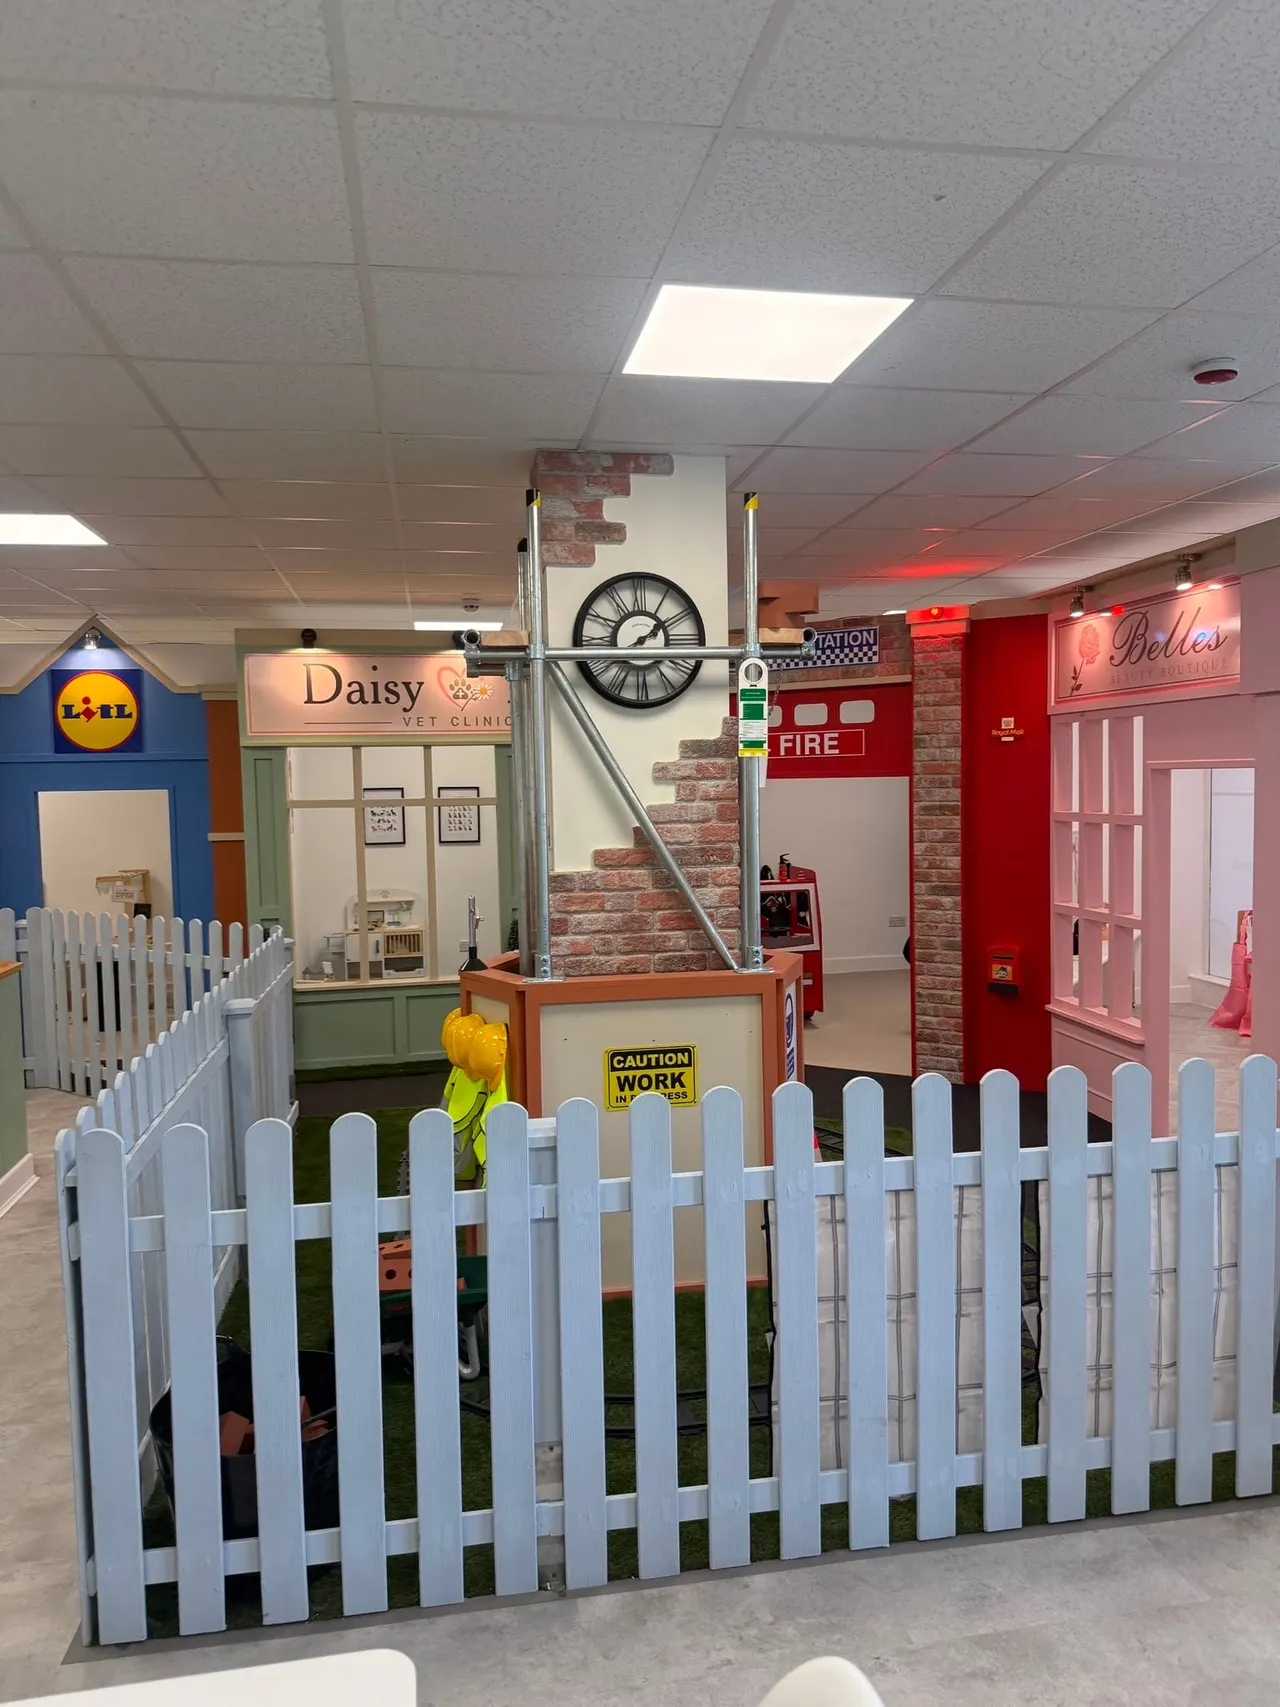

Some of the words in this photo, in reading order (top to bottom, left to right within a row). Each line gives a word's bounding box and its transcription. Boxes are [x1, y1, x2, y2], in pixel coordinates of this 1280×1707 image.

[816, 630, 874, 649] TATION
[1109, 607, 1228, 667] Belles
[1110, 668, 1154, 685] BEAUTY
[1160, 657, 1229, 678] BOUTIQUE
[302, 663, 425, 713] Daisy
[402, 716, 437, 727] VET
[451, 716, 512, 727] CLINIC
[991, 729, 1010, 737] Royal
[780, 732, 840, 756] FIRE
[613, 1053, 688, 1068] CAUTION
[616, 1072, 686, 1092] WORK
[615, 1095, 627, 1104] IN
